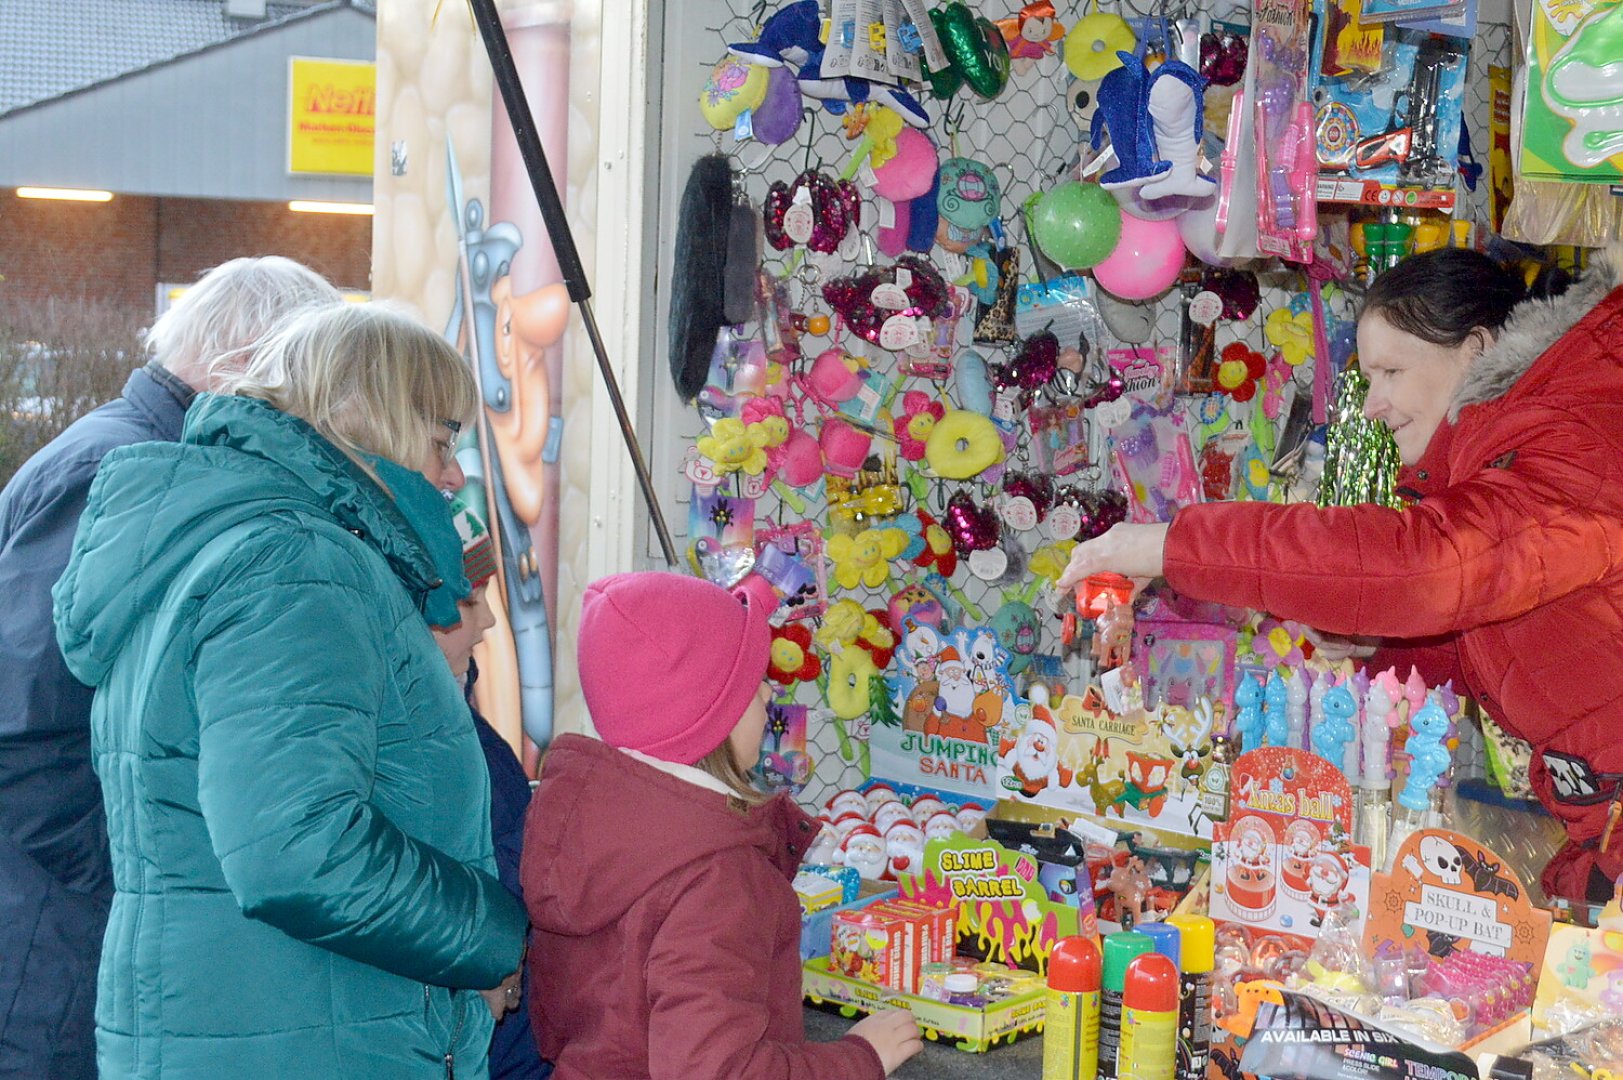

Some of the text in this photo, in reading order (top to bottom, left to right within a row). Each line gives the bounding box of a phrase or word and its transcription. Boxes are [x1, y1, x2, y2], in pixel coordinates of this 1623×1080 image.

[1071, 715, 1136, 736] SANTA CARRIAGE
[919, 757, 987, 785] SANTA
[1297, 787, 1334, 822] ball
[942, 851, 996, 871] SLIME
[952, 877, 1023, 897] BARREL
[1427, 891, 1493, 919] SKULL &
[1414, 908, 1503, 940] POP-UP BAT
[1260, 1029, 1400, 1044] AVAILABLE IN SIX
[1378, 1055, 1399, 1069] GIRL
